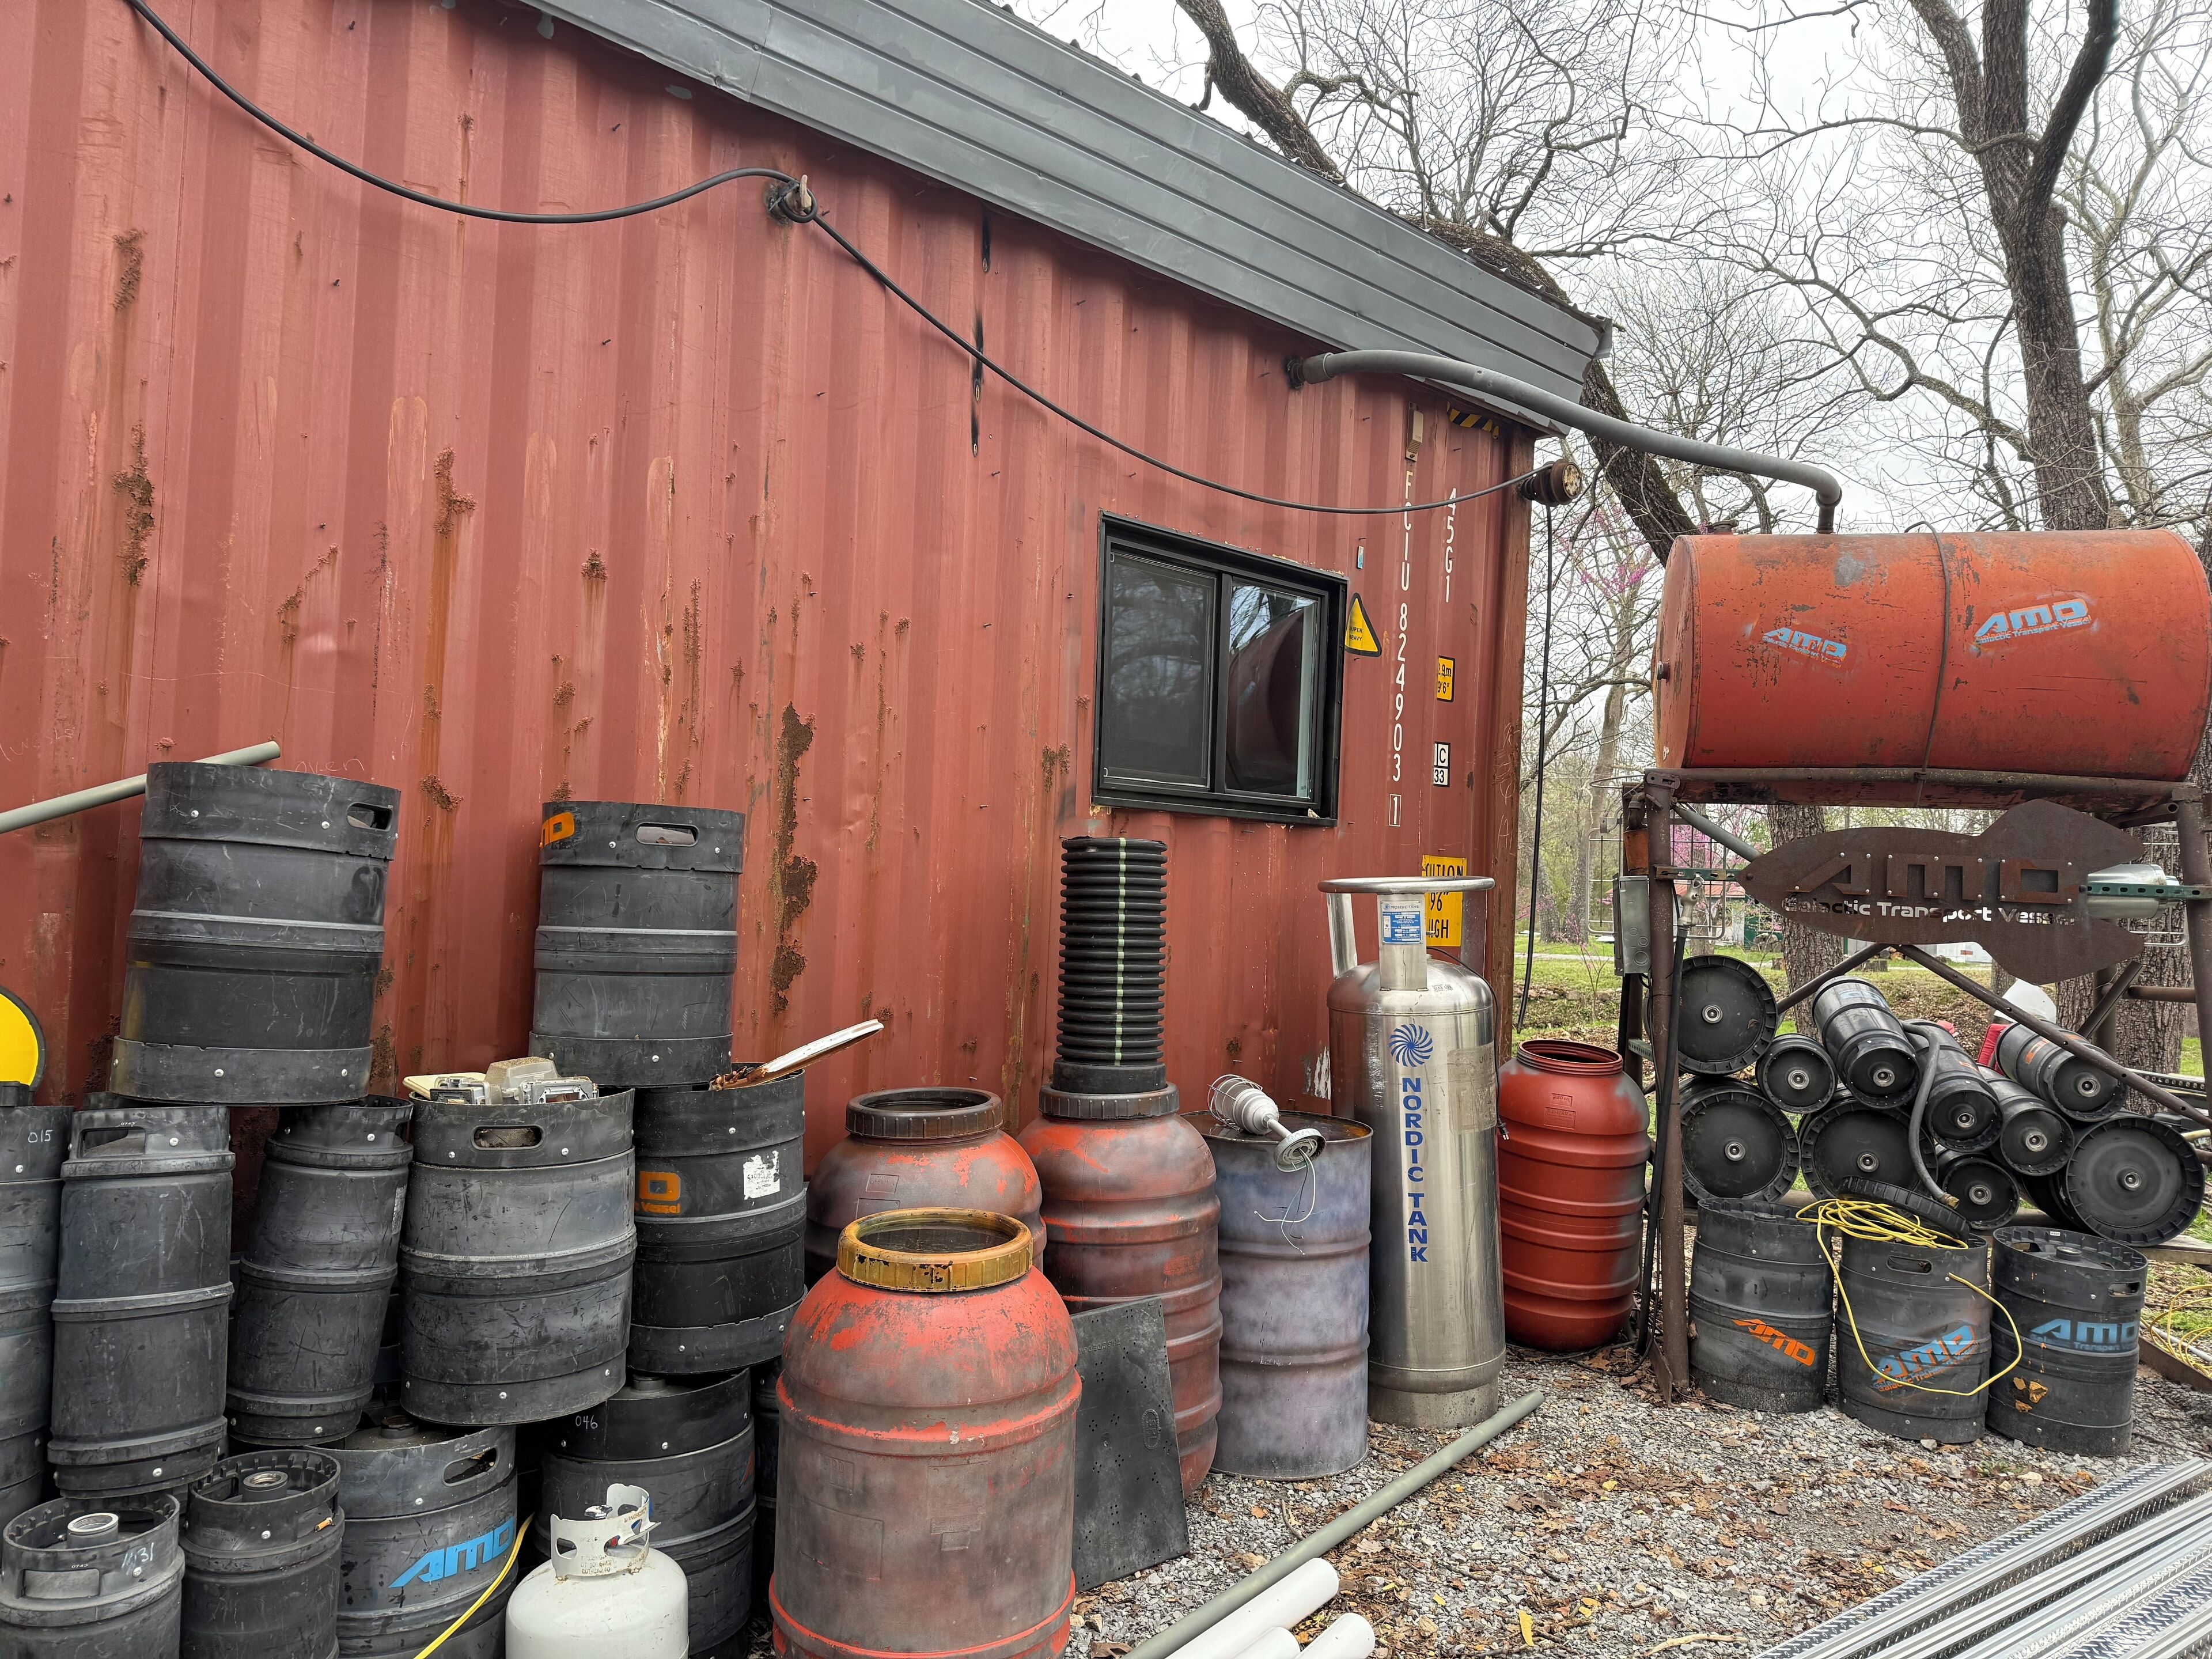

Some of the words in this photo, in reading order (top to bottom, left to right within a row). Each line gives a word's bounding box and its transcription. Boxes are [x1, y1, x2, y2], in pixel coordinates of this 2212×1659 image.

[1401, 470, 1414, 592] FCIU
[1445, 488, 1457, 603] 45G1
[1392, 603, 1408, 782] 824903
[1434, 769, 1445, 783] 33
[1782, 897, 1870, 915] Galactic
[1877, 902, 1992, 923] Transport
[28, 1129, 52, 1143] 015
[1402, 1077, 1423, 1182] NORDIC
[1407, 1192, 1429, 1263] TANK
[575, 1414, 598, 1430] 046
